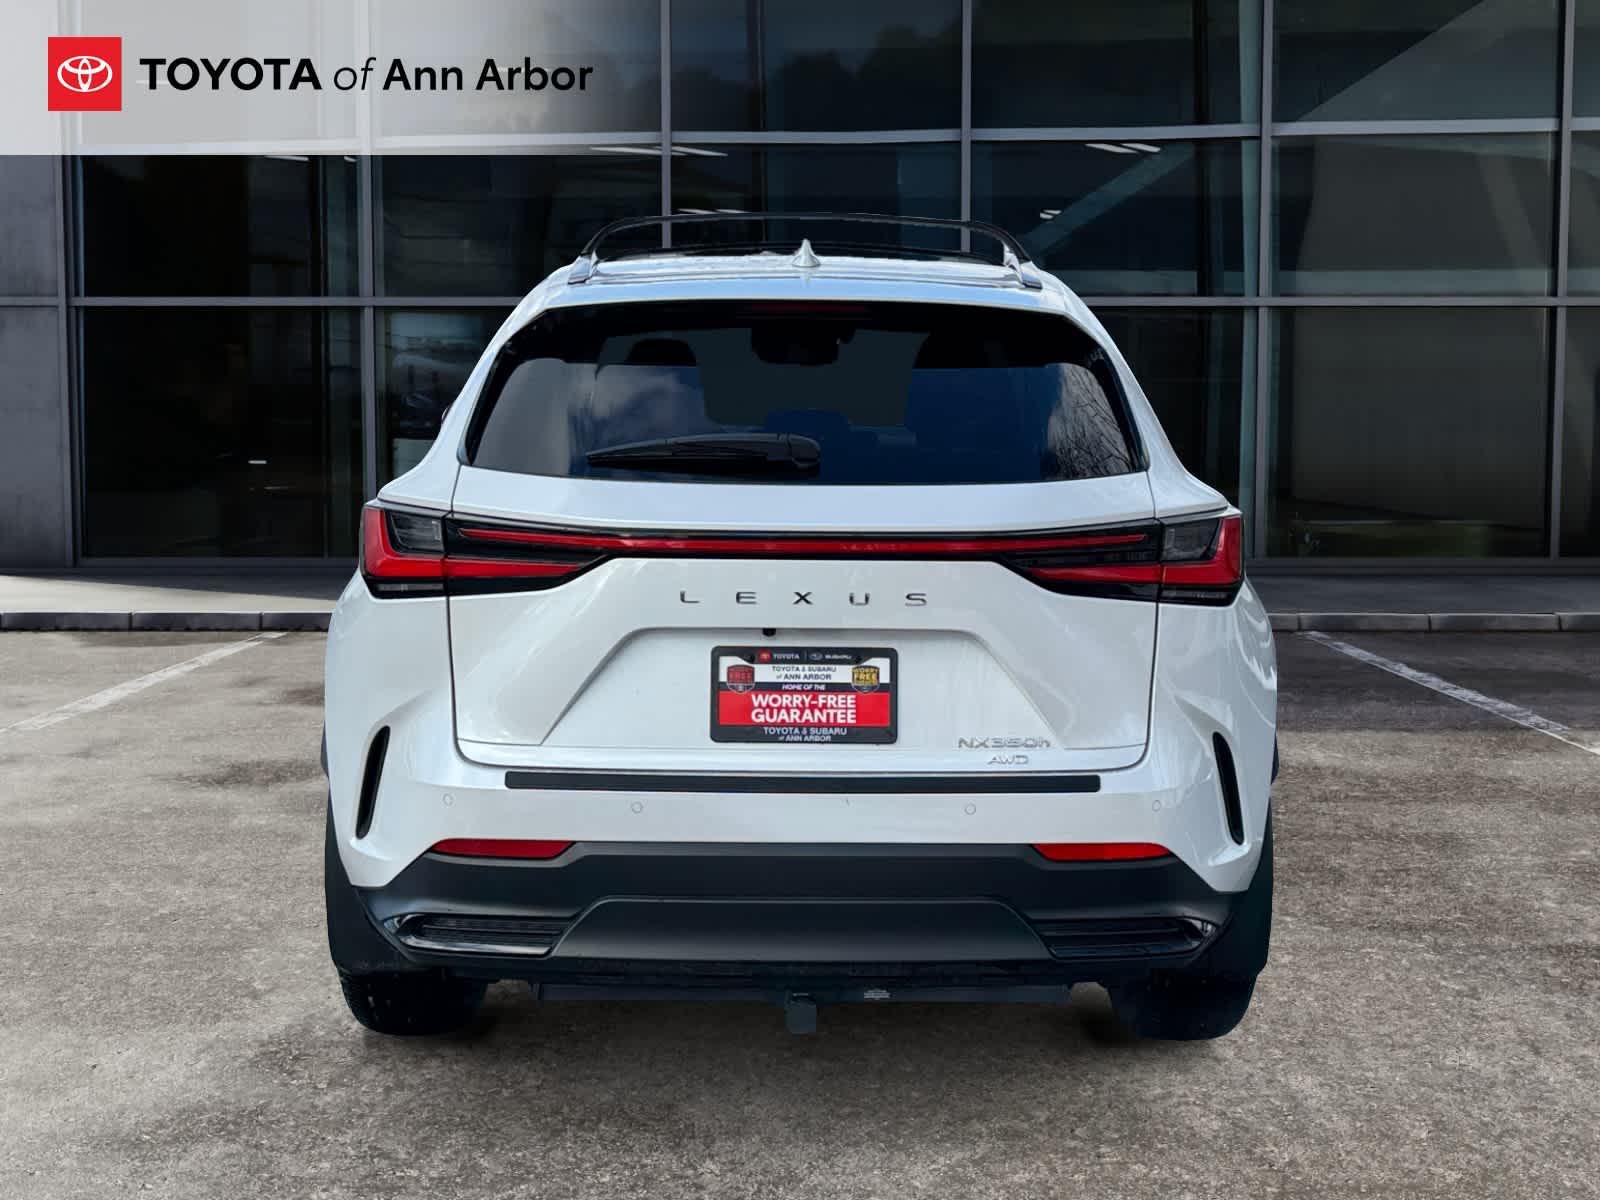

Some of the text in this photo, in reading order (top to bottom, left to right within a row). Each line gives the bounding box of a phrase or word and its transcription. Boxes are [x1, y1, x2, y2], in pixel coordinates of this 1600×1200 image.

[680, 591, 928, 607] LEXUS
[751, 694, 856, 708] WORRY-FREE
[751, 708, 857, 723] GUARANTEE
[763, 727, 800, 735] TOYOTA
[809, 727, 848, 735] SUBARU
[987, 754, 1030, 765] AWD
